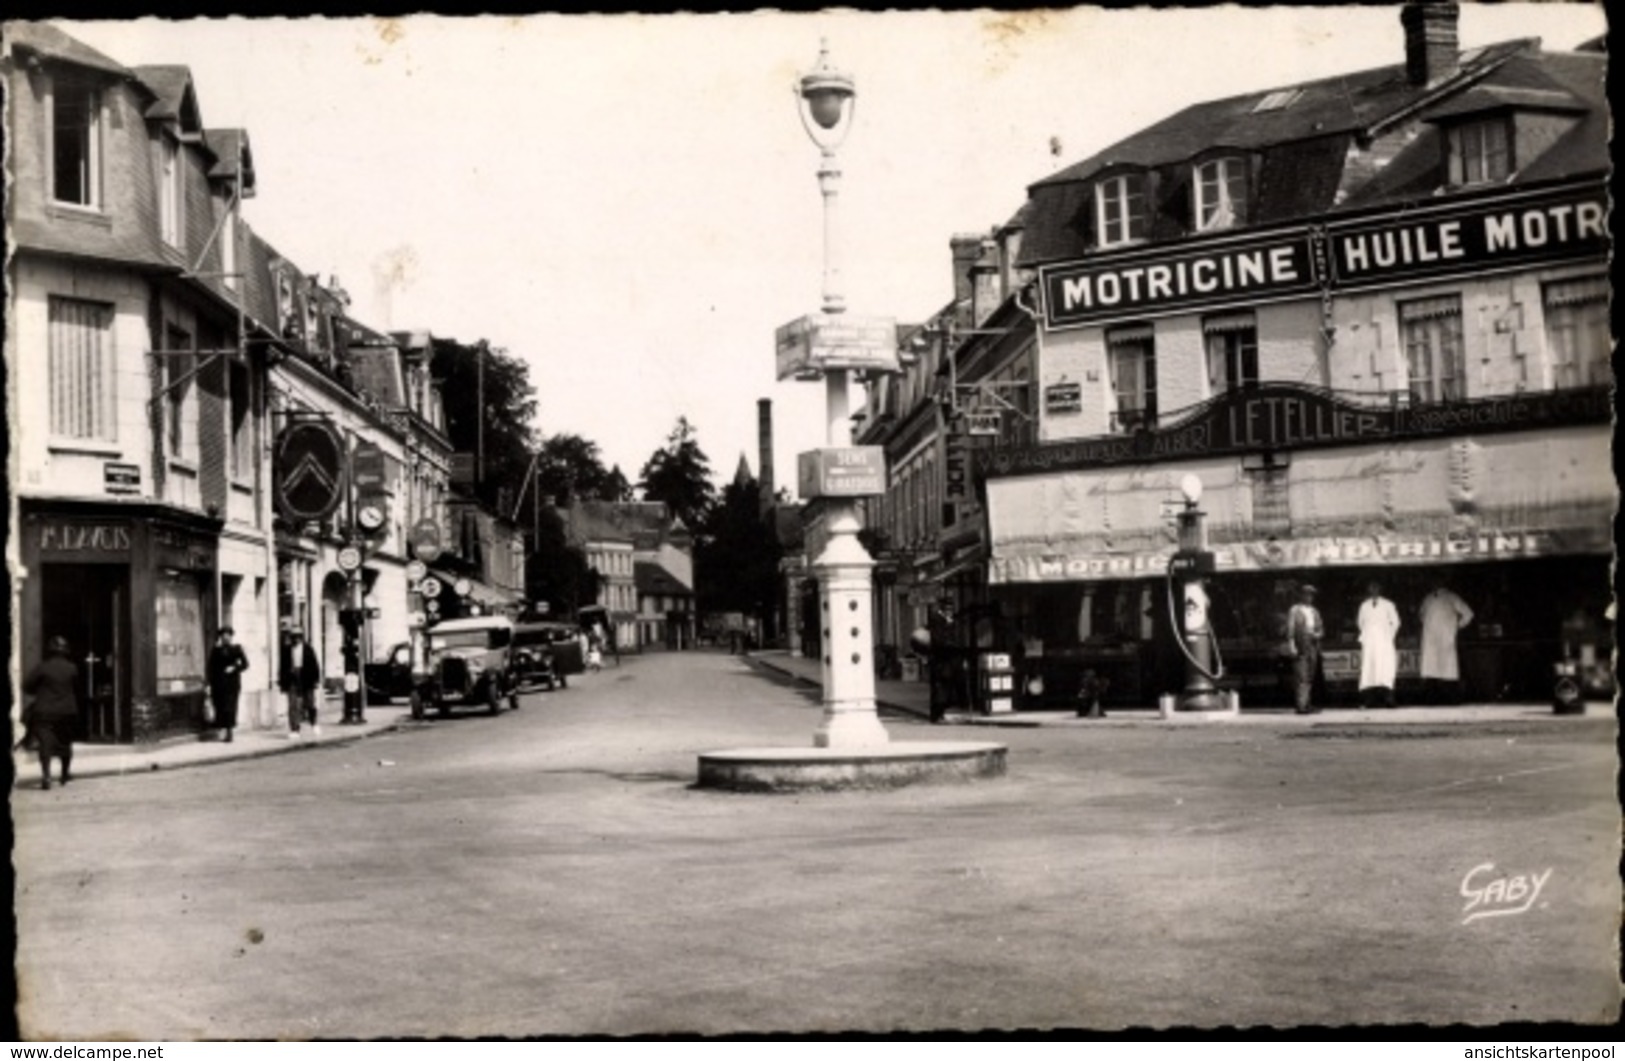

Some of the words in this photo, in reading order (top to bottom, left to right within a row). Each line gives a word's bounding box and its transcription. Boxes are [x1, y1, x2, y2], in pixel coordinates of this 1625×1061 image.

[1344, 221, 1465, 272] HUILE
[1483, 201, 1605, 252] MOTR
[1062, 246, 1298, 310] MOTRICINE
